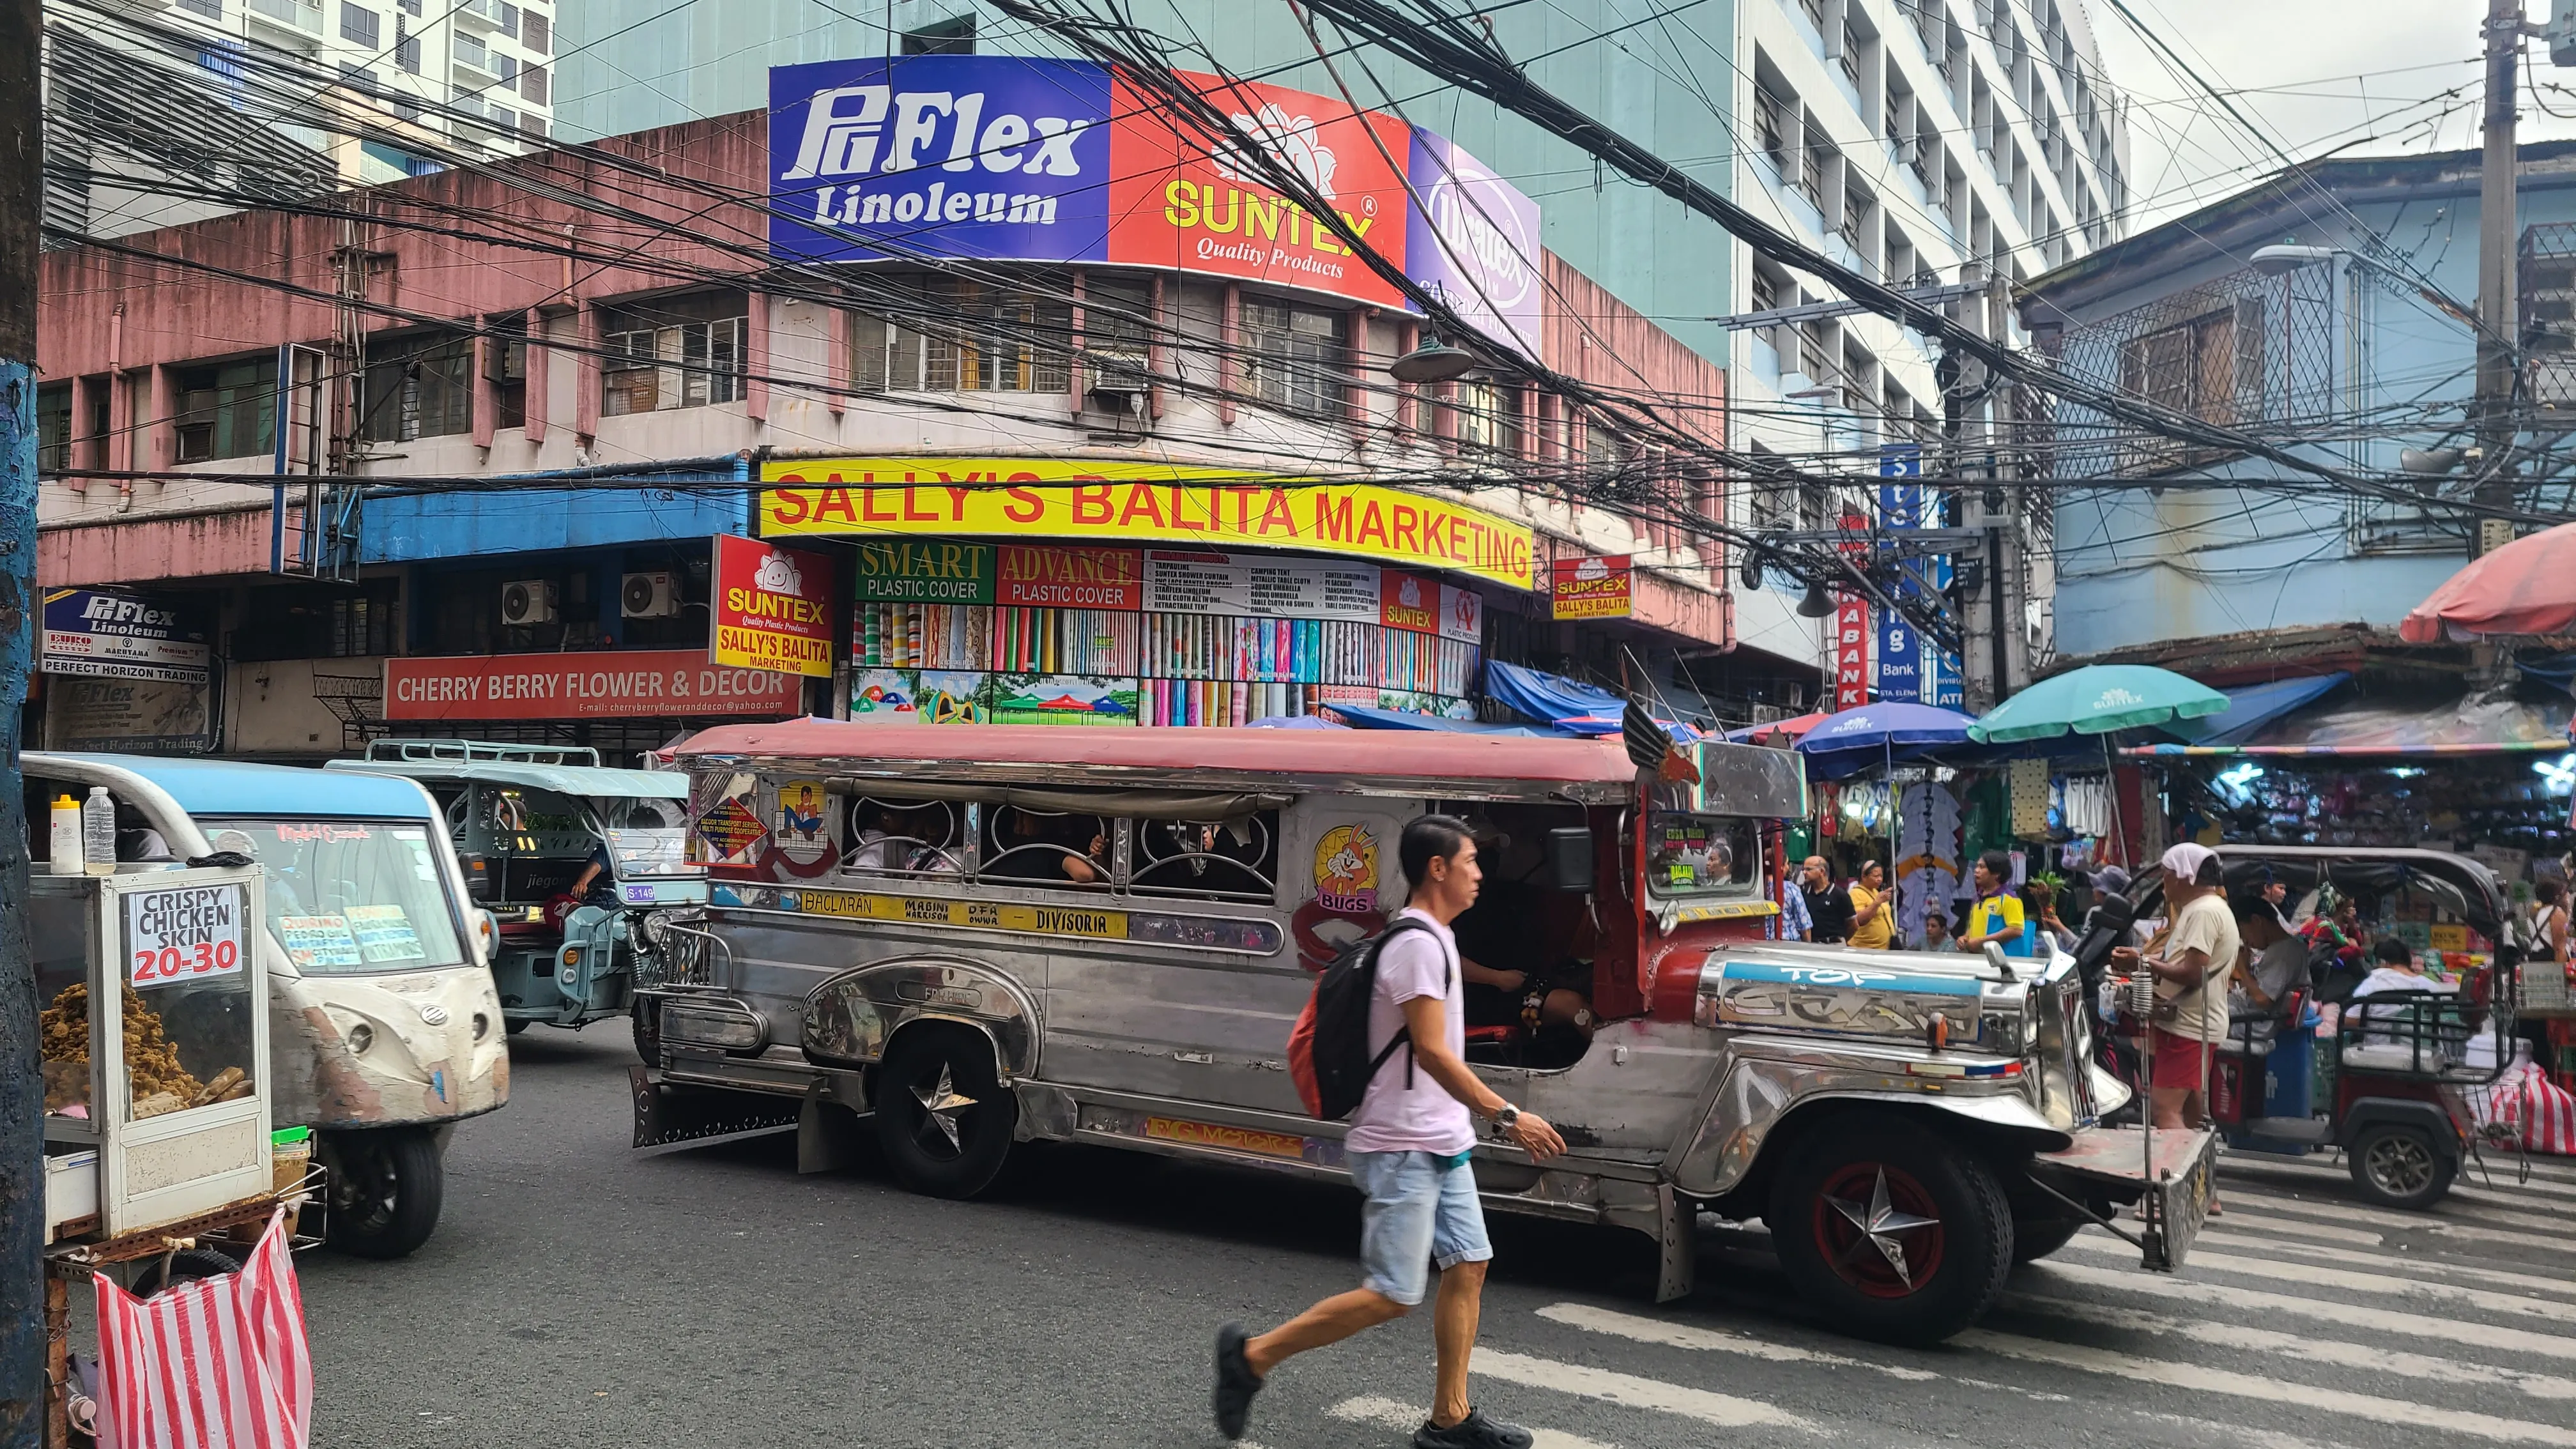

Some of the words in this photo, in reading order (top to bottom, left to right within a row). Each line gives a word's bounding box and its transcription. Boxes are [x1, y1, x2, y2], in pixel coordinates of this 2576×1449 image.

[813, 181, 1058, 226] Linoleum
[1164, 180, 1374, 258] SUNTEX
[1440, 192, 1525, 288] Uratex
[1197, 237, 1265, 266] Quality
[1271, 240, 1344, 279] Products
[772, 471, 1045, 525] SALLY'S
[1072, 475, 1299, 538] BALITA
[1315, 493, 1528, 578] MARKETING
[861, 542, 987, 579] SMART
[1002, 548, 1133, 586] ADVANCE
[1151, 551, 1188, 562] AVAILABLE
[1155, 562, 1190, 571] TARPAULINE
[868, 579, 924, 597] PLASTIC
[929, 581, 977, 599] COVER
[1013, 583, 1064, 602] PLASTIC
[1068, 586, 1124, 604] COVER
[1558, 578, 1627, 594] SUNTEX
[728, 587, 825, 625] SUNTEX
[1556, 601, 1593, 613] SALLY'S
[1597, 598, 1629, 610] BALITA
[742, 615, 763, 628] Quality
[765, 620, 783, 630] Plastic
[785, 623, 808, 634] Products
[1388, 605, 1431, 628] SUNTEX
[90, 620, 167, 638] Linoleum
[1447, 628, 1462, 638] PLASTIC
[50, 634, 91, 645] EURO
[721, 629, 778, 656] SALLY'S
[782, 638, 829, 663] BALITA
[105, 648, 149, 657] MARUYAMA
[158, 646, 188, 656] Premium
[45, 661, 98, 674] PERFECT
[102, 665, 154, 678] HORIZON
[157, 670, 206, 682] TRADING
[749, 656, 801, 671] MARKETING
[1883, 663, 1914, 676] Bank
[397, 677, 480, 702] CHERRY
[488, 675, 559, 700] BERRY
[566, 672, 663, 698] FLOWER
[671, 671, 690, 697] &
[699, 670, 784, 696] DECOR
[579, 703, 608, 712] E-mail:
[610, 701, 783, 712] cherryberryfloweranddecor@yahoo.com
[109, 740, 154, 751] Horizon
[158, 739, 203, 751] Trading
[734, 827, 761, 836] COOPERATIVE
[144, 888, 224, 912] CRISPY
[1322, 894, 1367, 911] BUGS
[140, 904, 229, 935] CHICKEN
[805, 893, 871, 914] BACLARAN
[905, 900, 949, 914] MABINI
[968, 905, 999, 916] DFA
[1036, 910, 1107, 933] DIVISORIA
[905, 910, 949, 922] HARRISON
[969, 916, 999, 925] OWWA
[158, 927, 212, 949] SKIN
[134, 940, 237, 981] 20-30
[1781, 967, 1896, 986] TOP
